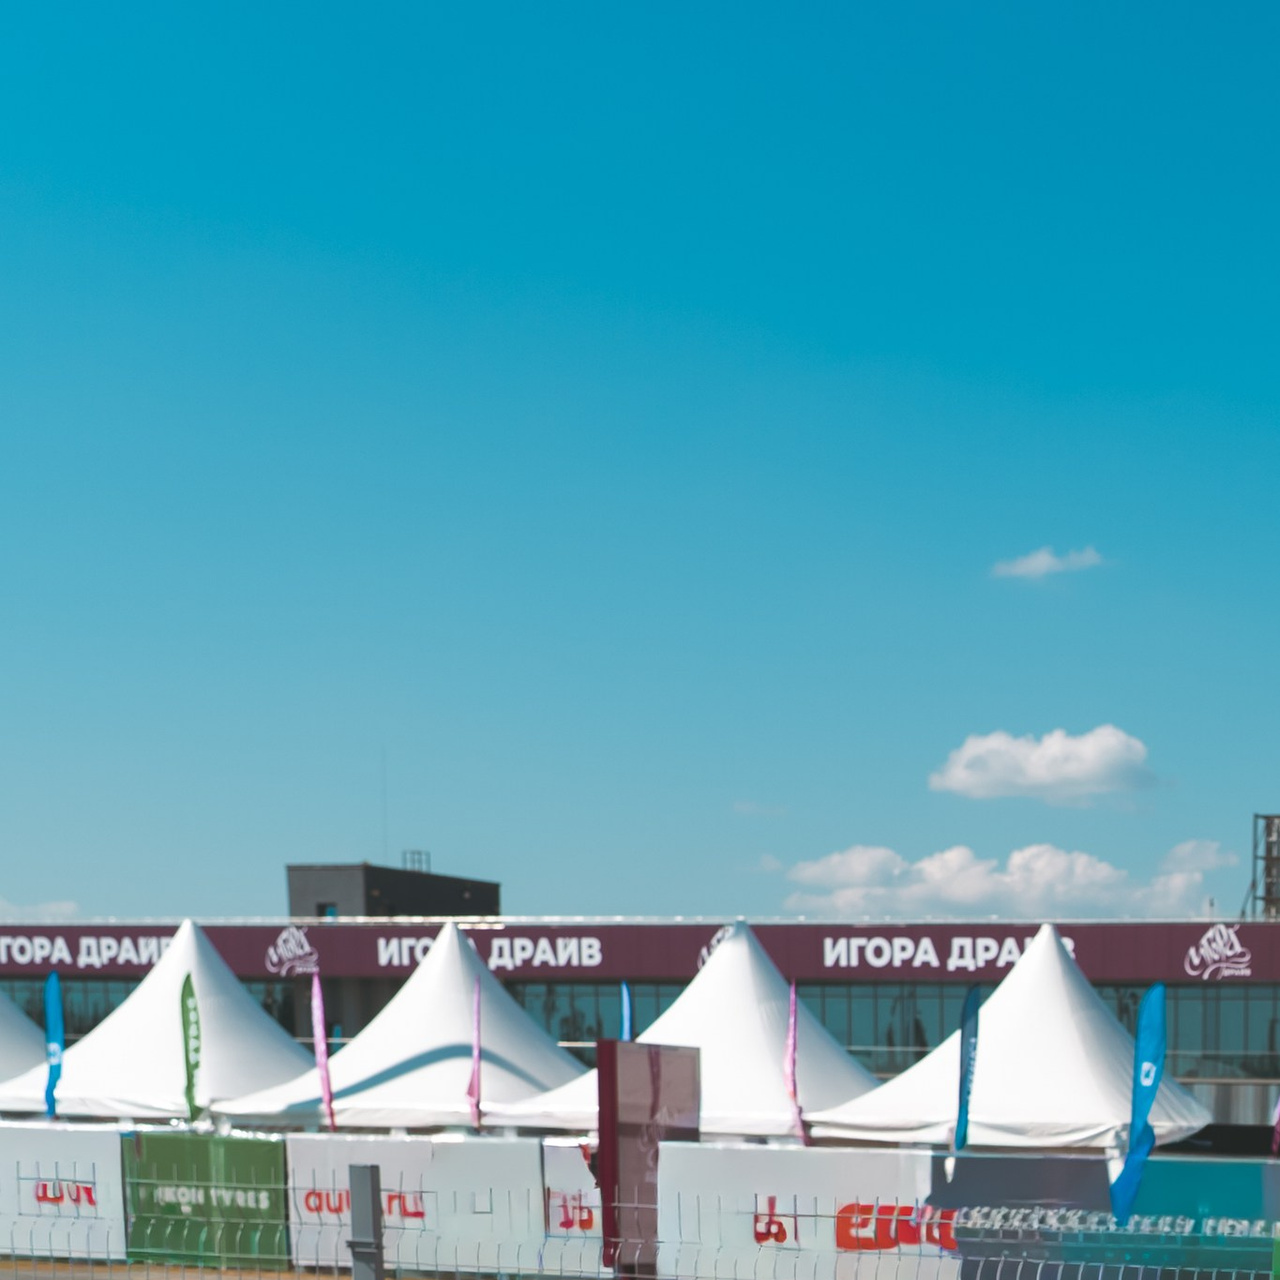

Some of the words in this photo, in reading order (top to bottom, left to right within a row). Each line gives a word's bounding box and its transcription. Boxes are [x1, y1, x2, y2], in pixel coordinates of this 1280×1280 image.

[76, 935, 176, 968] ДРАЙ
[488, 936, 603, 971] ДРАЙВ
[823, 936, 940, 968] ИГОРА
[946, 935, 1077, 972] ДРА
